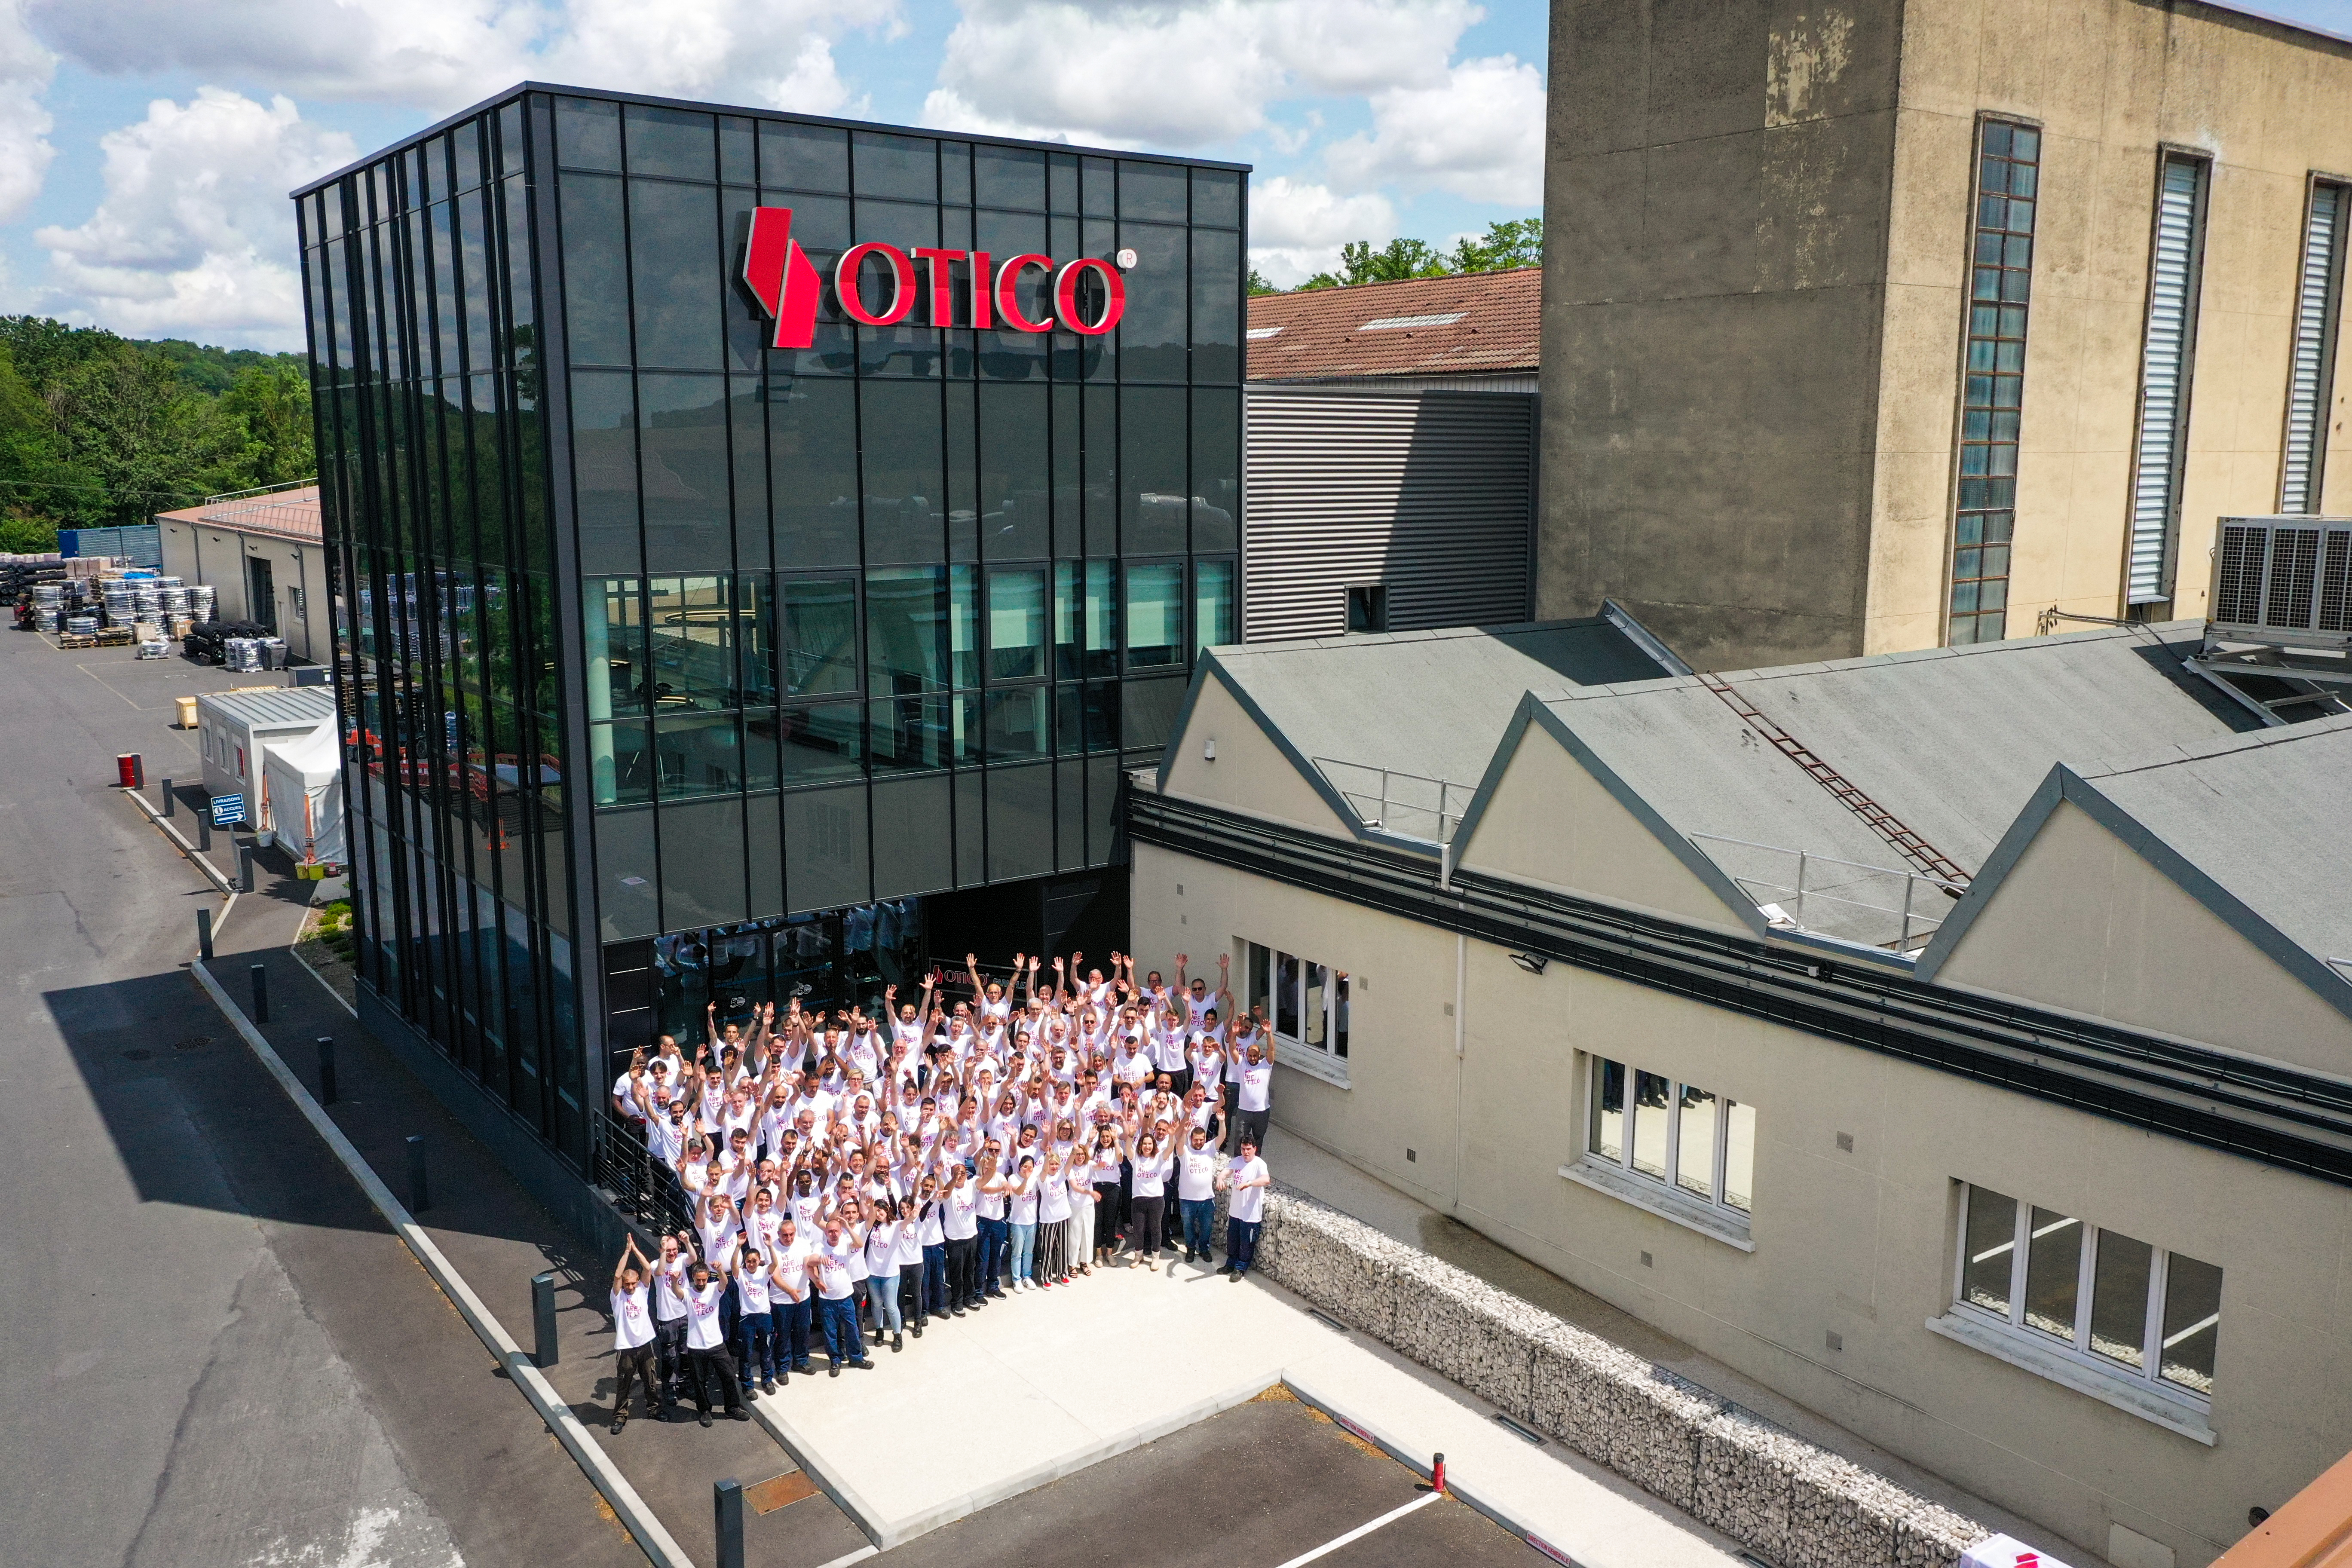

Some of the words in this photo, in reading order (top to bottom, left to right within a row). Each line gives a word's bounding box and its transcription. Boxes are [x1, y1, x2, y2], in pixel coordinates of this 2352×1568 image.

[835, 242, 1126, 335] OTICO
[870, 1238, 888, 1248] OTICO
[782, 1265, 804, 1273] OTICO
[825, 1263, 845, 1273] OTICO
[696, 1306, 714, 1316] TICO
[1340, 1417, 1357, 1431] DIRECTION
[1528, 1534, 1548, 1551] DIRECTION
[1548, 1547, 1569, 1565] GENERALE
